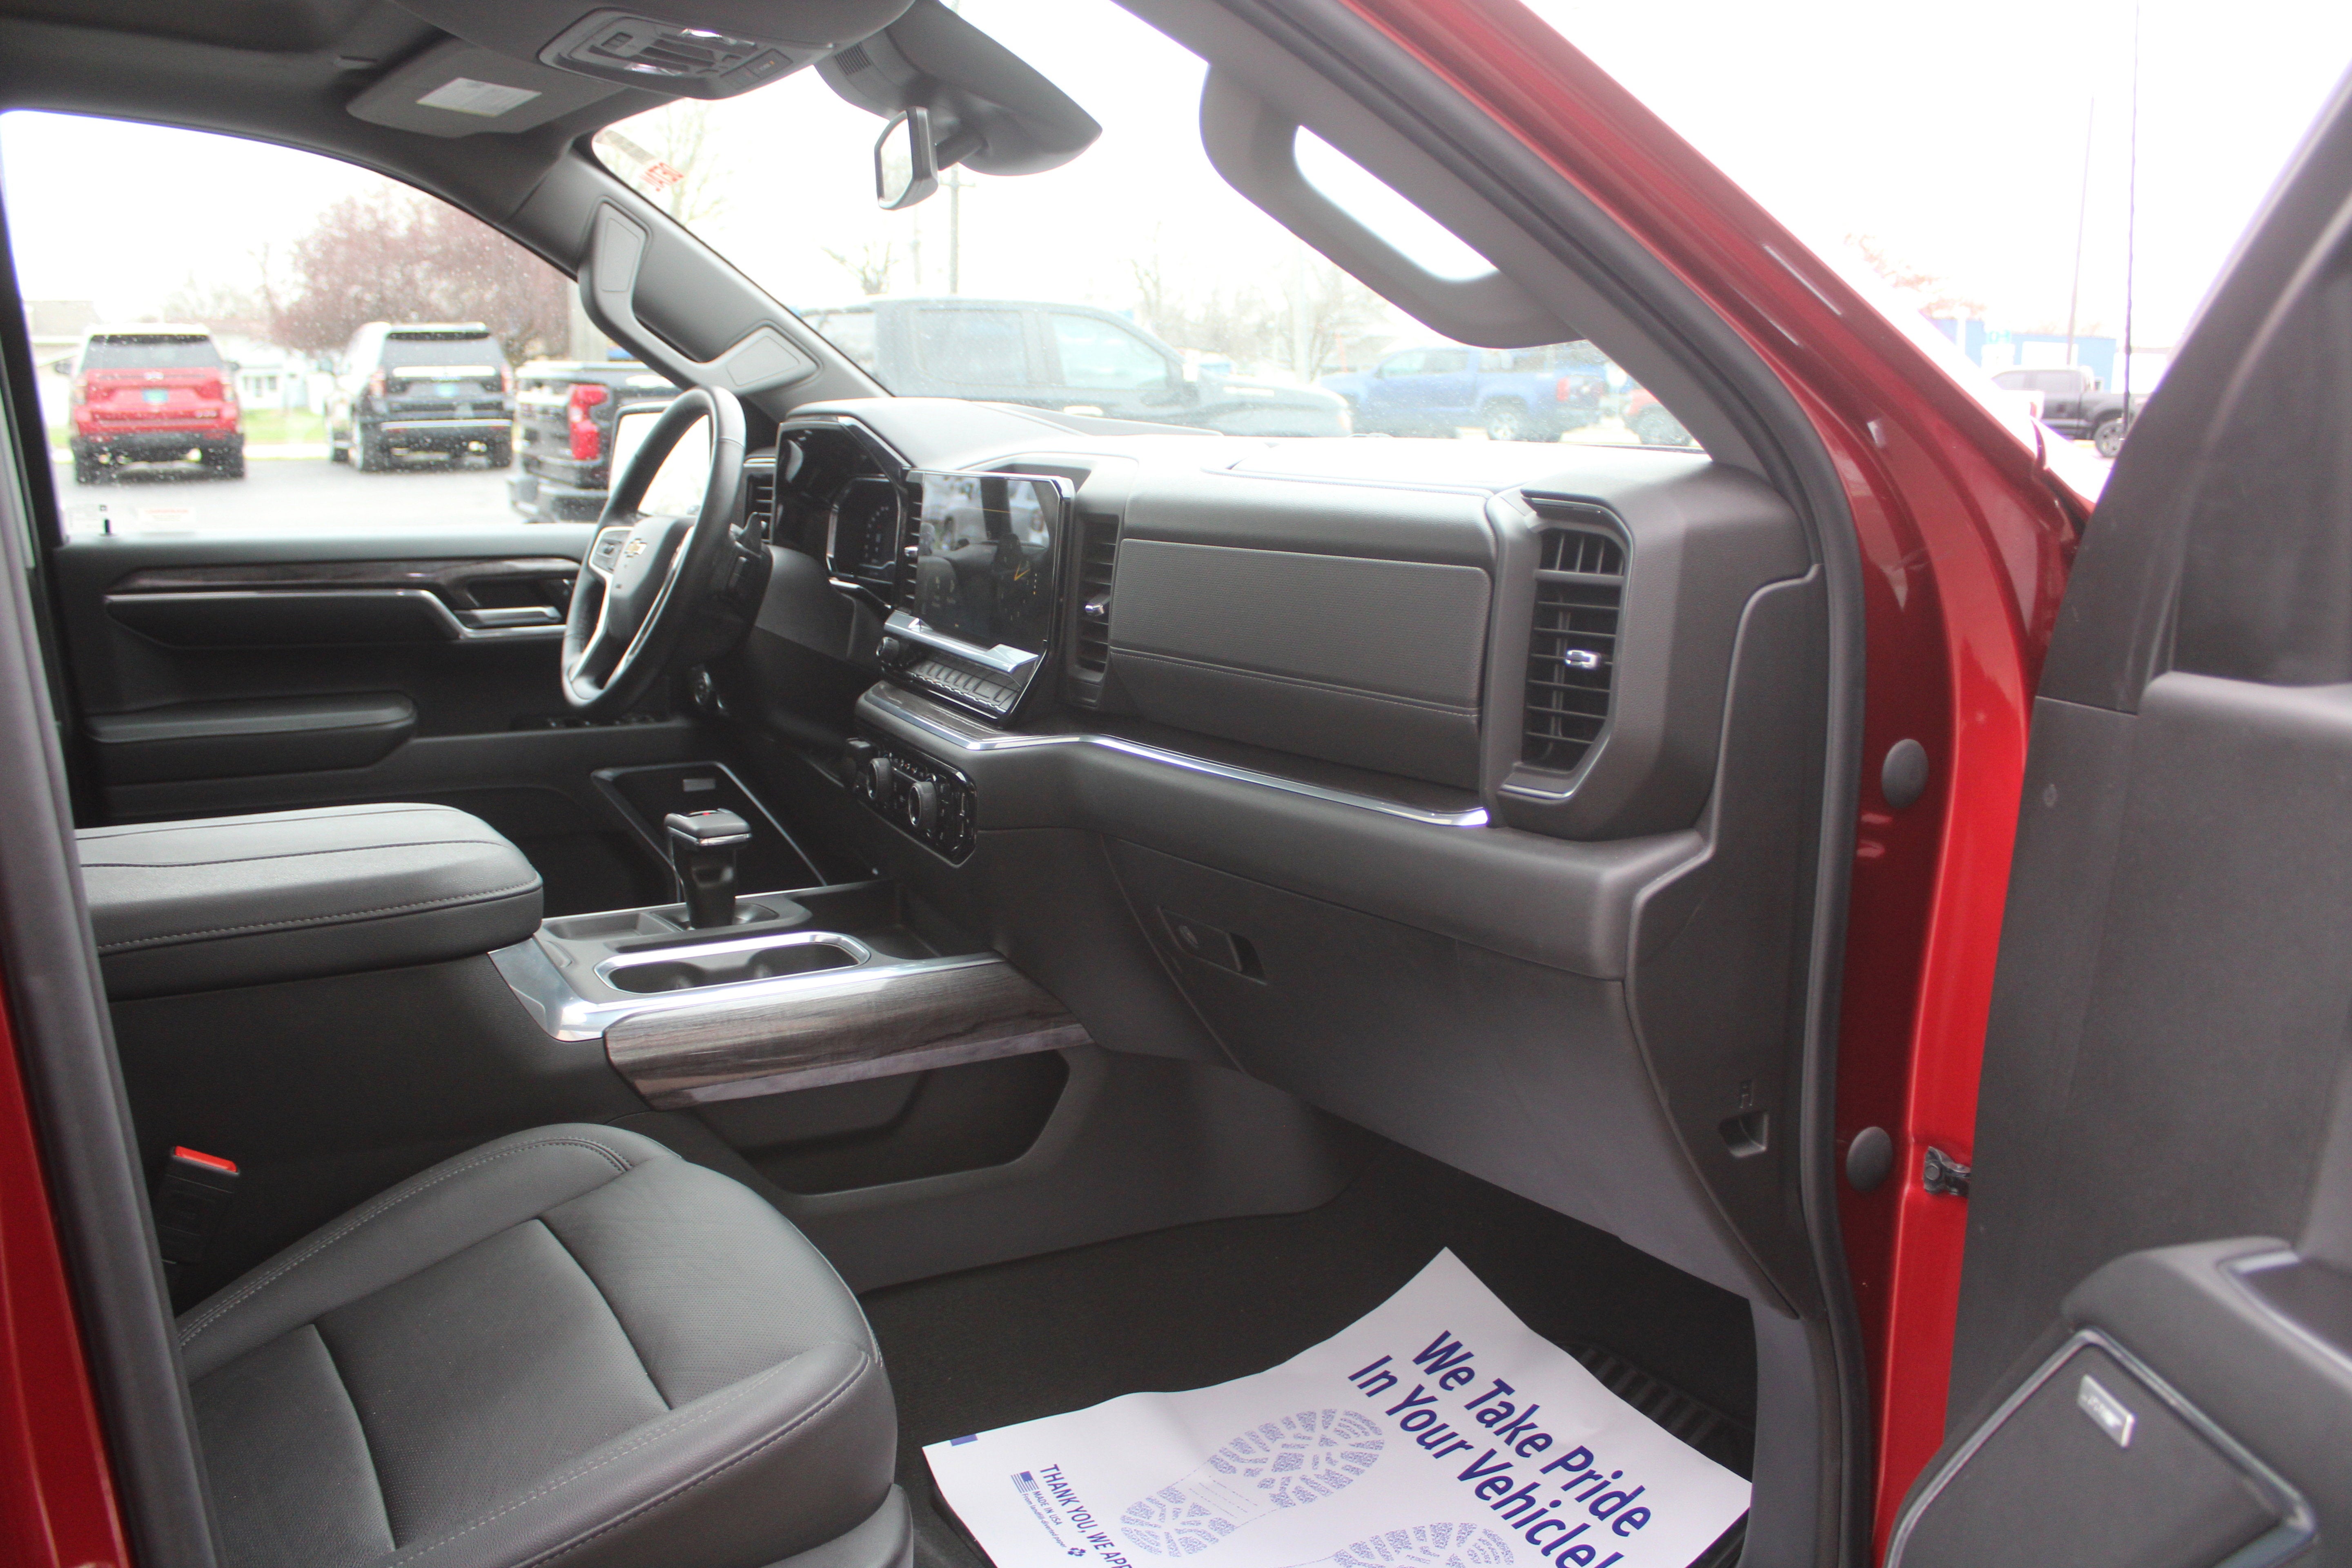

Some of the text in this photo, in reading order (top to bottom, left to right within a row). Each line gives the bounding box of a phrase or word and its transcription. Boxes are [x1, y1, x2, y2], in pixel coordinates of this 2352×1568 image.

[1348, 1355, 1398, 1397] In
[1385, 1384, 1474, 1459] Your
[1413, 1331, 1651, 1537] We Take Pride
[1022, 1493, 1033, 1505] From
[1052, 1536, 1067, 1548] paper
[1032, 1491, 1050, 1507] MADE
[1049, 1514, 1063, 1526] USA
[1040, 1464, 1080, 1506] THANK
[1067, 1506, 1098, 1533] YOU,
[1086, 1532, 1115, 1550] WE
